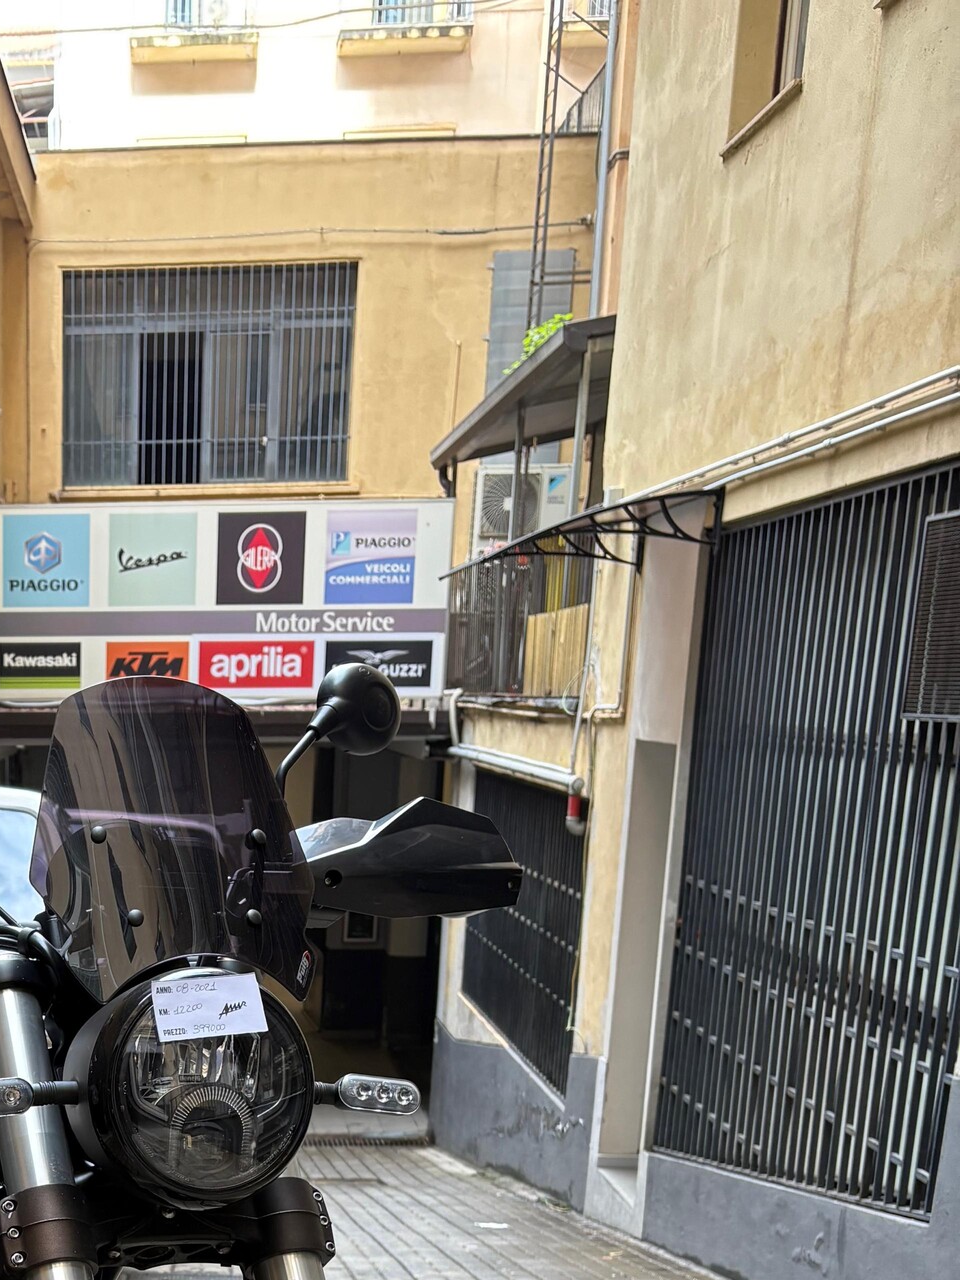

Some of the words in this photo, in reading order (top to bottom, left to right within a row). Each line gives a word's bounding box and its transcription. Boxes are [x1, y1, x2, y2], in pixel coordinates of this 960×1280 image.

[355, 537, 411, 549] PIAGGIO
[118, 548, 187, 573] Vespa
[241, 545, 280, 571] GILERA
[365, 563, 410, 573] VEICOLI
[9, 579, 79, 592] PIAGGIO
[329, 575, 410, 585] COMMERCIALI
[256, 612, 320, 632] Motor
[322, 612, 395, 632] Service
[3, 652, 77, 667] Kawasaki
[109, 652, 184, 677] KTM
[210, 646, 302, 684] aprilia
[377, 663, 423, 678] GUZZI
[155, 986, 174, 994] ANNO:
[158, 1008, 171, 1016] KM:
[173, 1002, 203, 1015] 12200
[162, 1027, 188, 1036] PREZZO:
